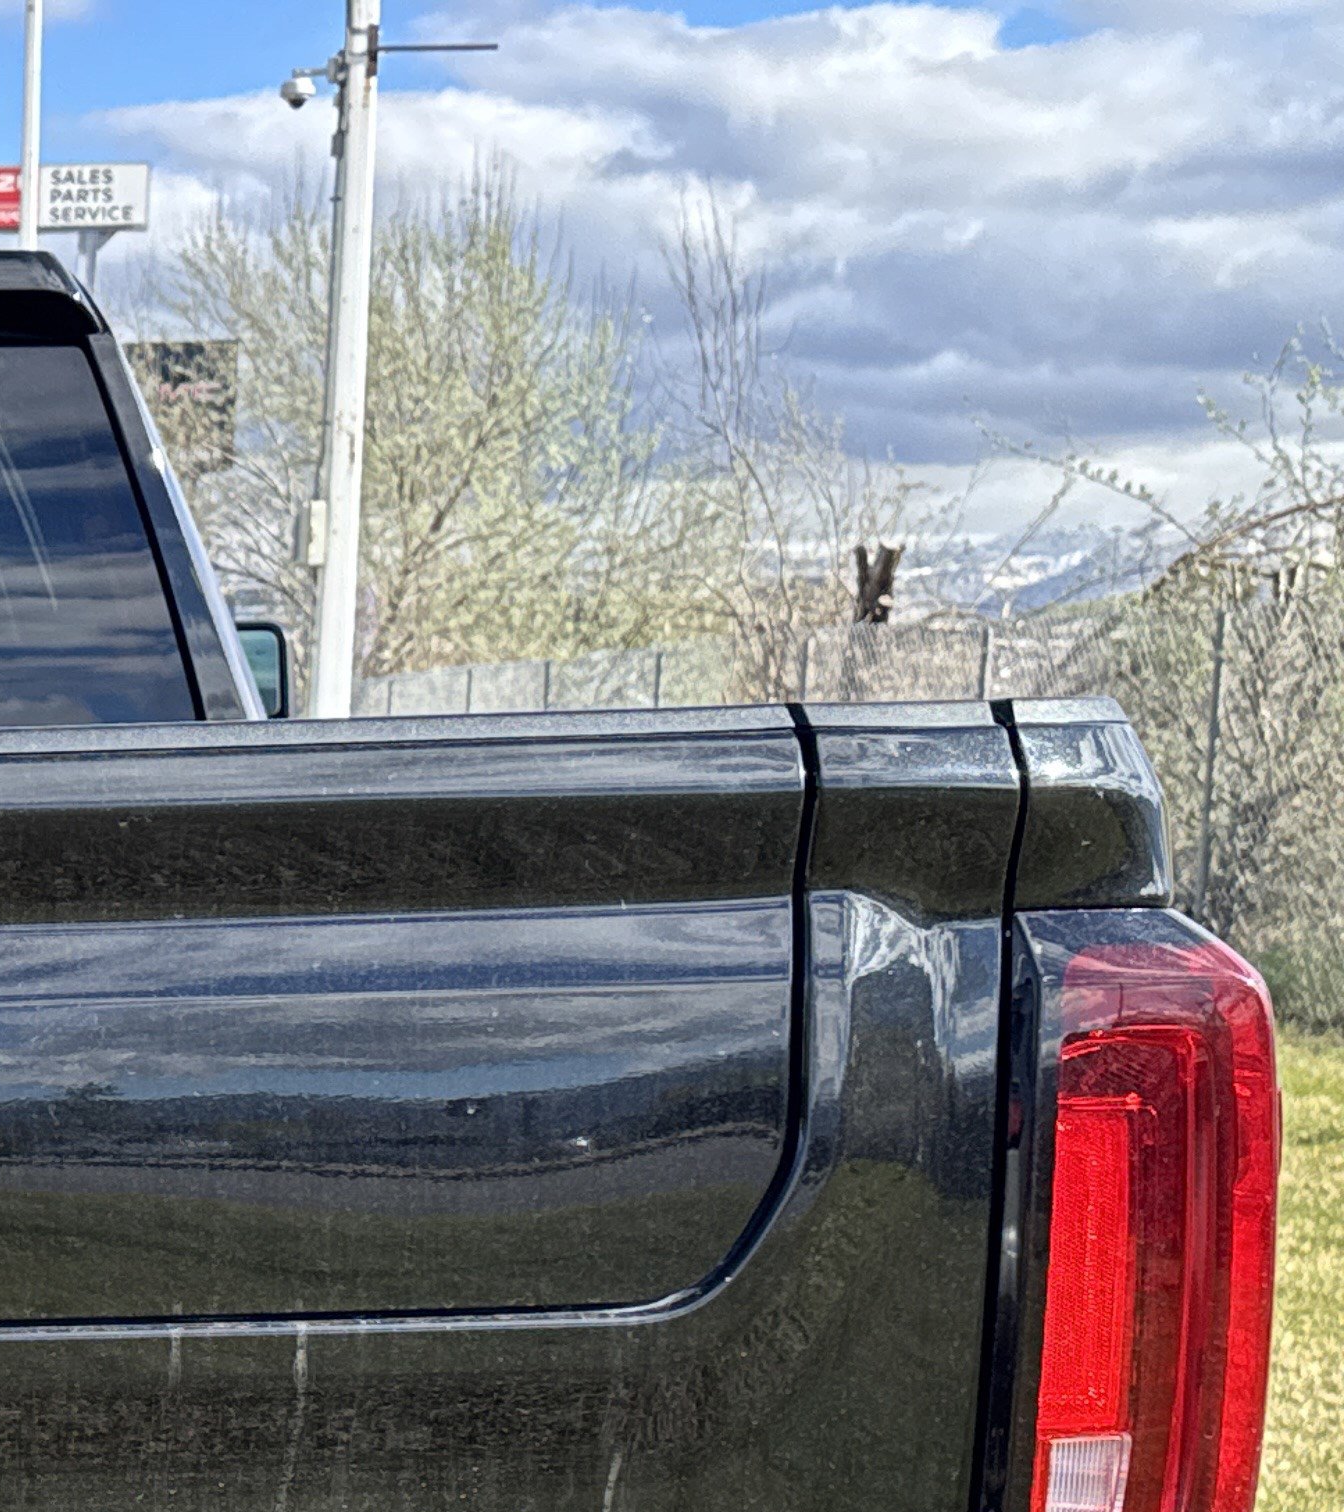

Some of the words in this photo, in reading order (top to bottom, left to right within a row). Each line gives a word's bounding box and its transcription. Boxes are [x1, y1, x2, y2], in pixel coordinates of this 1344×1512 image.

[50, 168, 113, 186] SALES
[49, 187, 113, 204] PARTS
[49, 205, 134, 223] SERVICE
